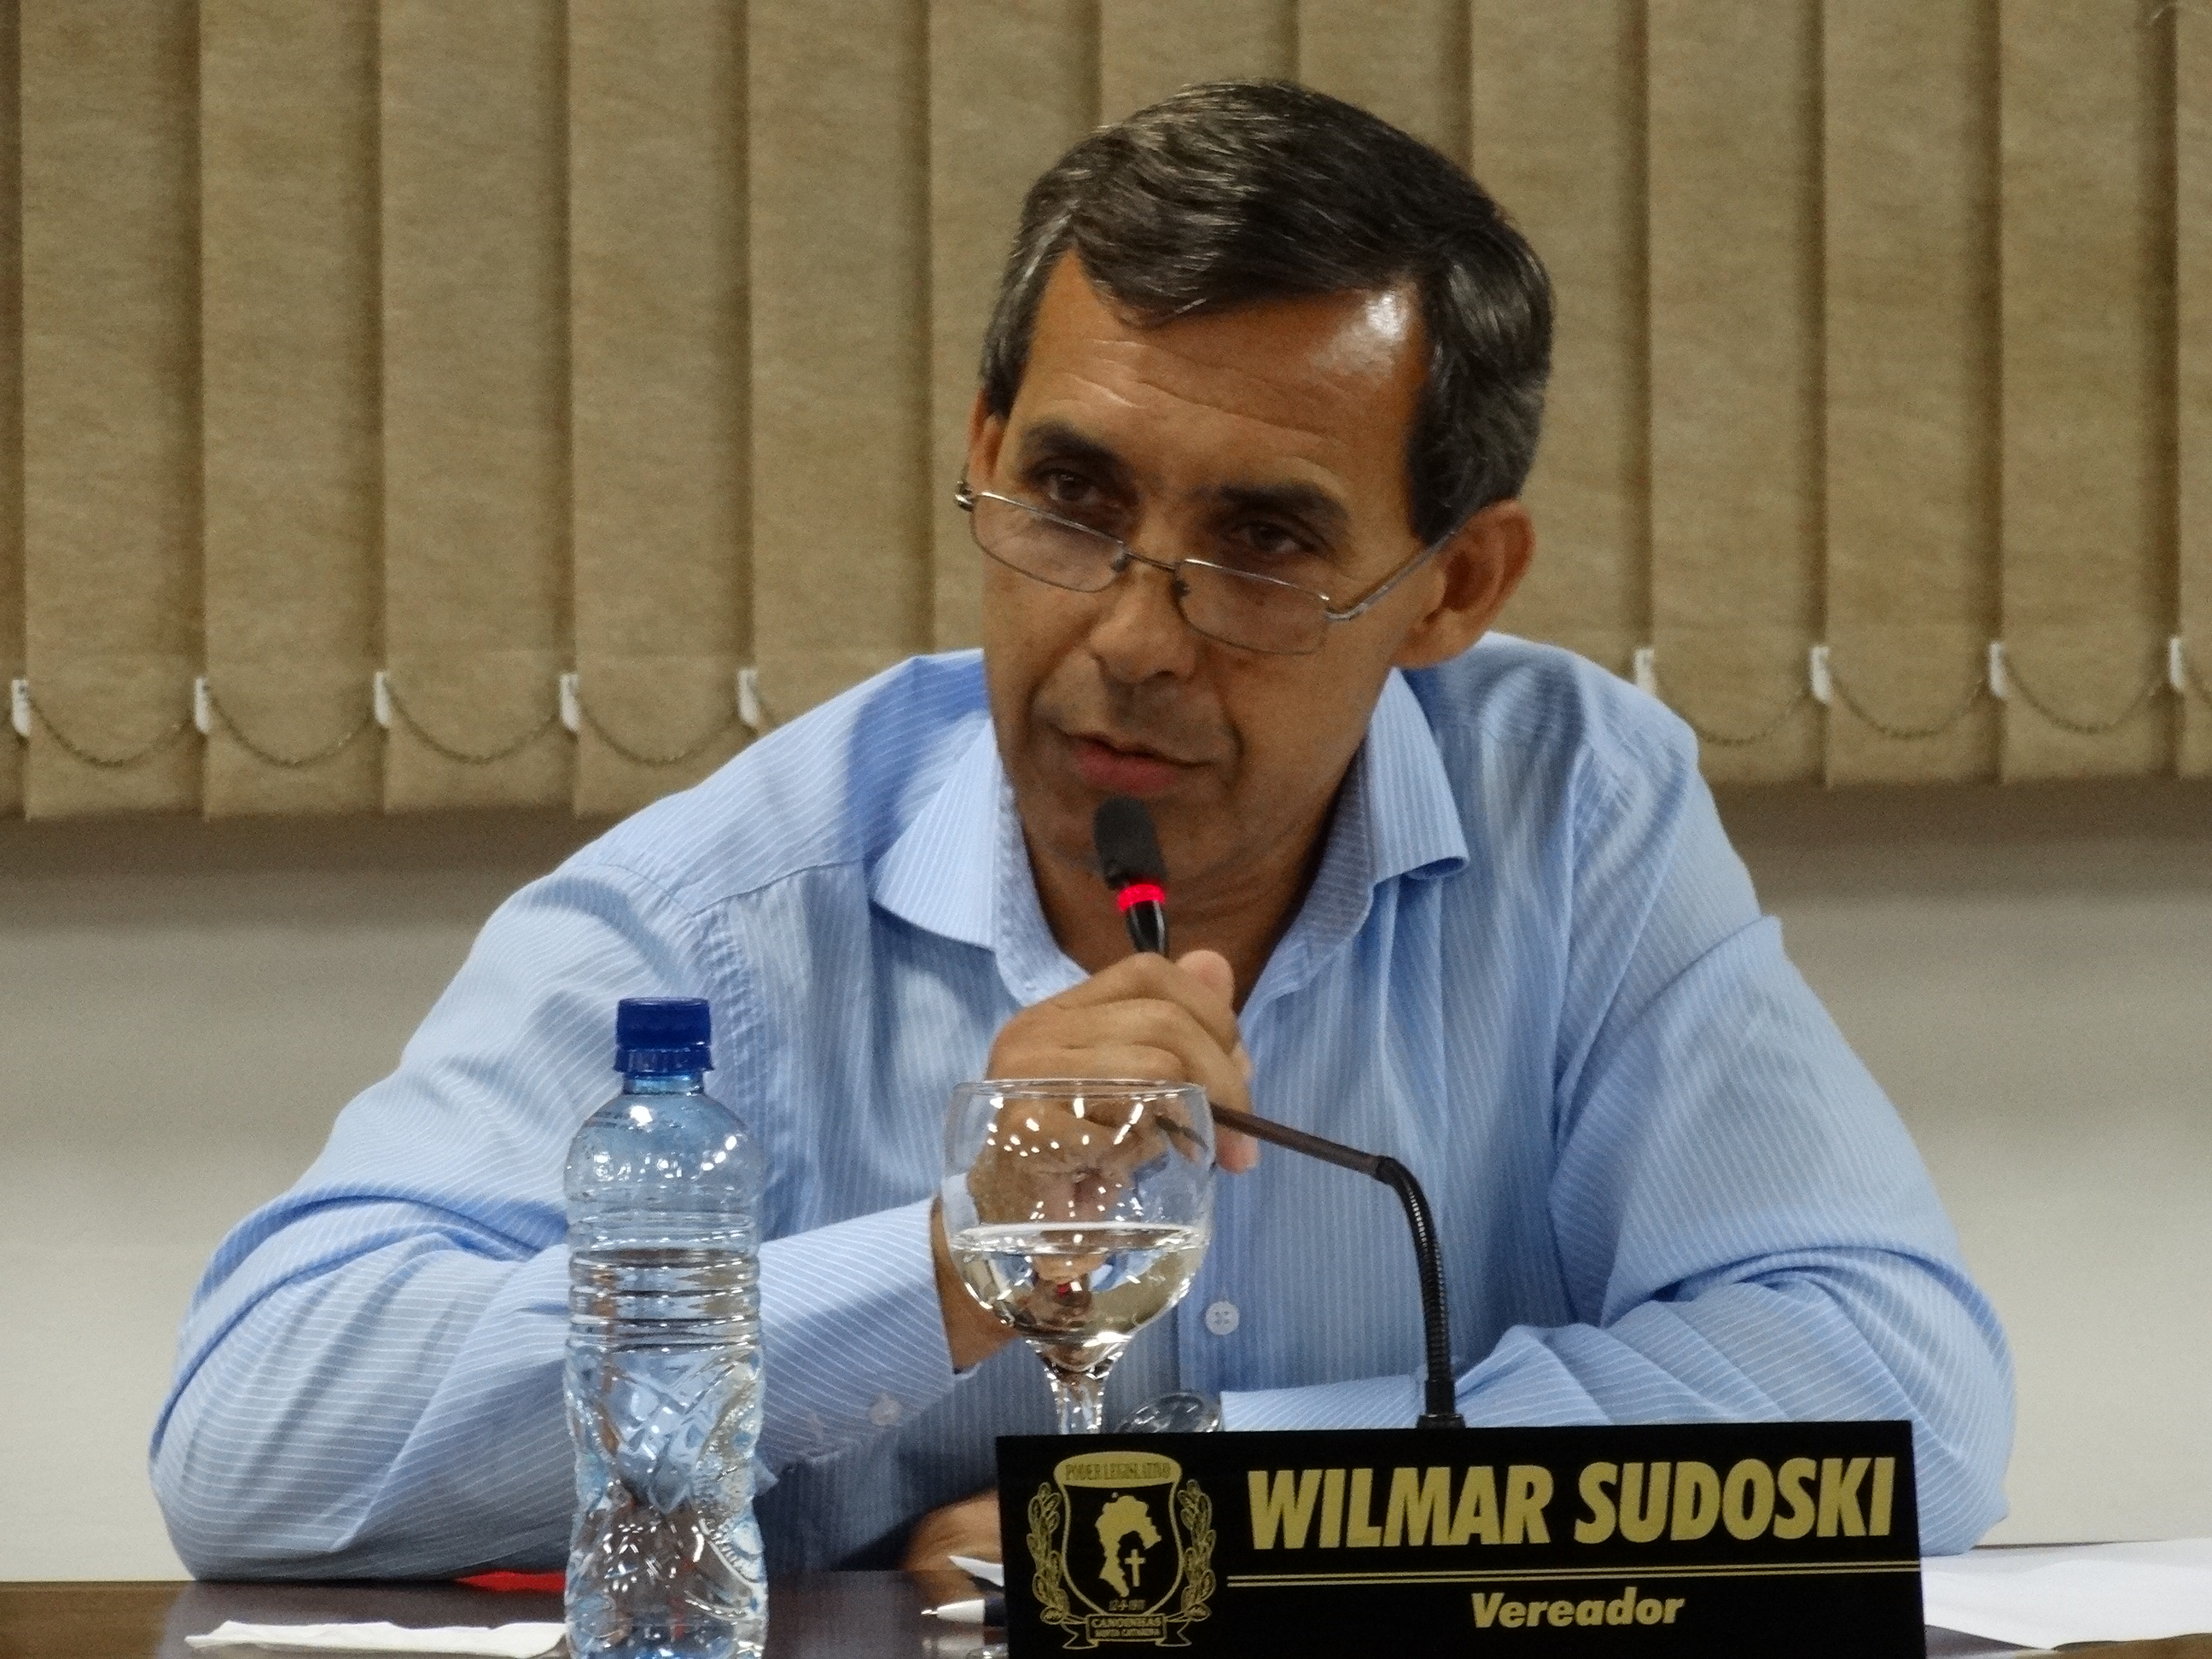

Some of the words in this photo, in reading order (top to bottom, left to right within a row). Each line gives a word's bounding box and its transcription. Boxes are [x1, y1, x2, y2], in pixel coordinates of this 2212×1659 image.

[1247, 1464, 1553, 1550] WILMAR
[1575, 1458, 1895, 1545] SUDOSKI
[1471, 1586, 1685, 1628] Vereador
